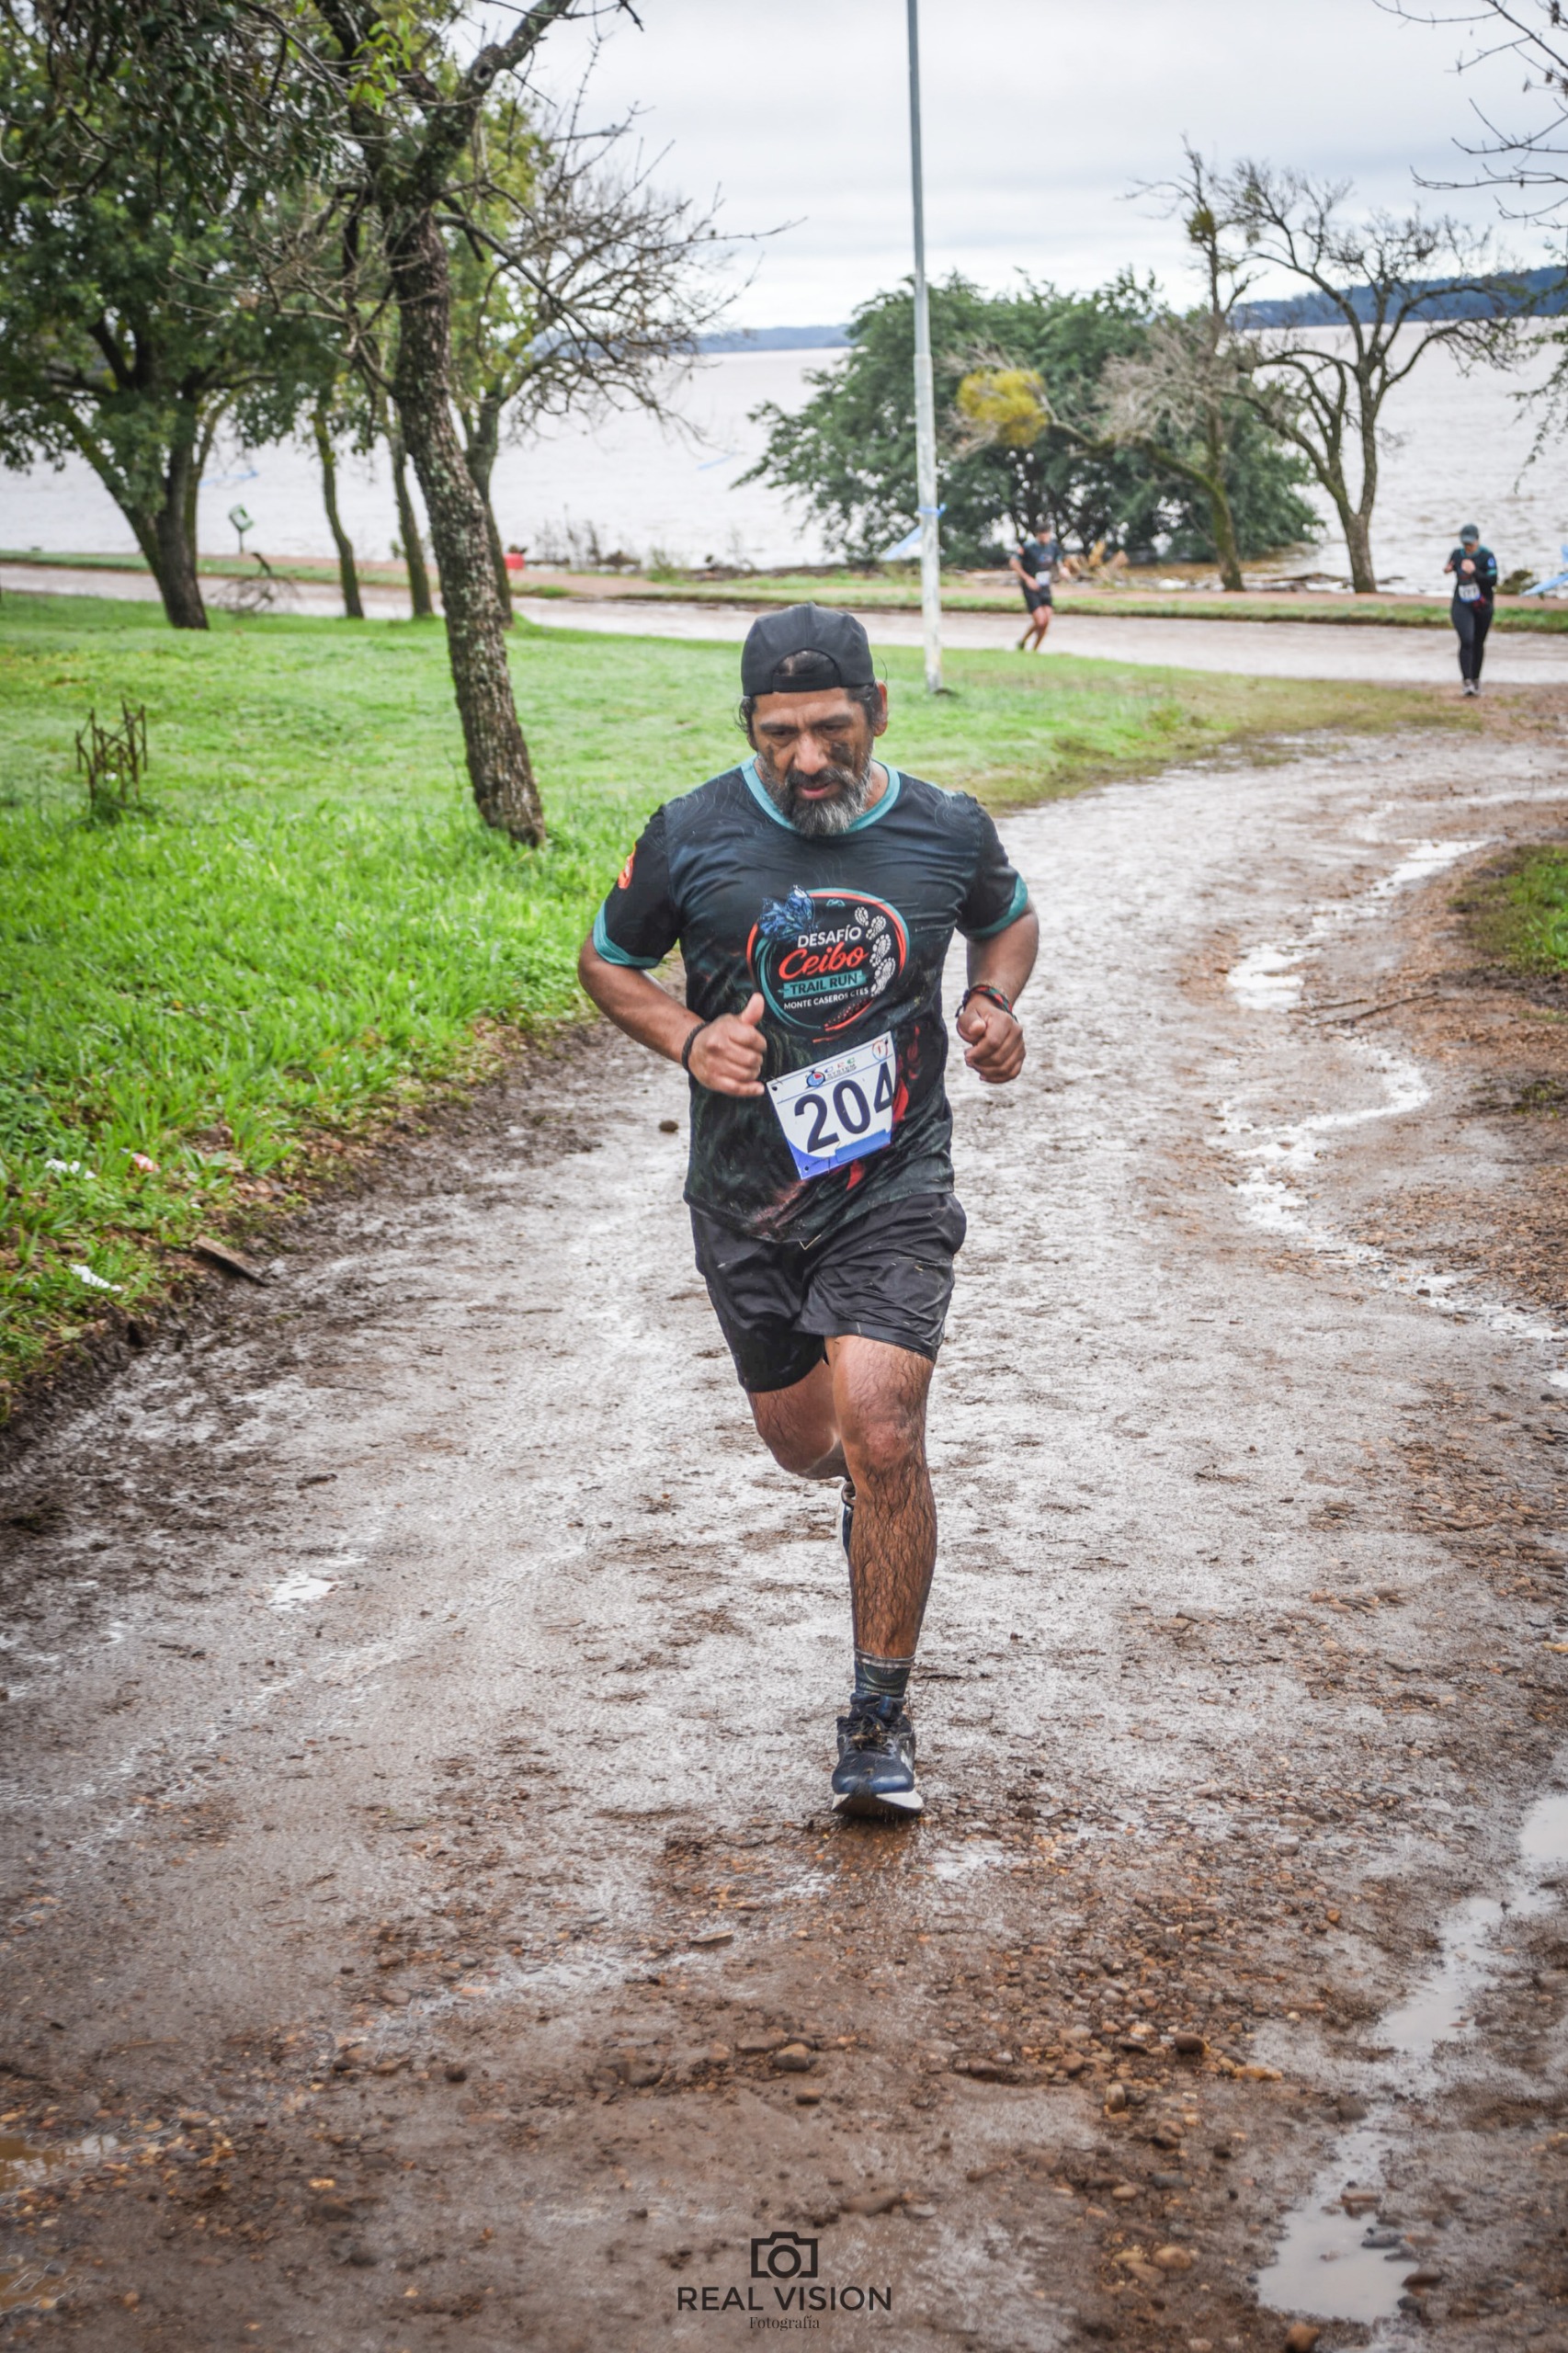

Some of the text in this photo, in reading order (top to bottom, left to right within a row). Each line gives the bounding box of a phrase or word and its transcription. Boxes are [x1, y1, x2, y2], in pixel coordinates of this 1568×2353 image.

[797, 925, 862, 949] DESAFÍO
[778, 941, 869, 981] Ceibo
[790, 973, 858, 995] TRAIL RUN
[783, 999, 812, 1010] MONTE
[812, 993, 848, 1006] CASEROS
[794, 1062, 894, 1154] 204
